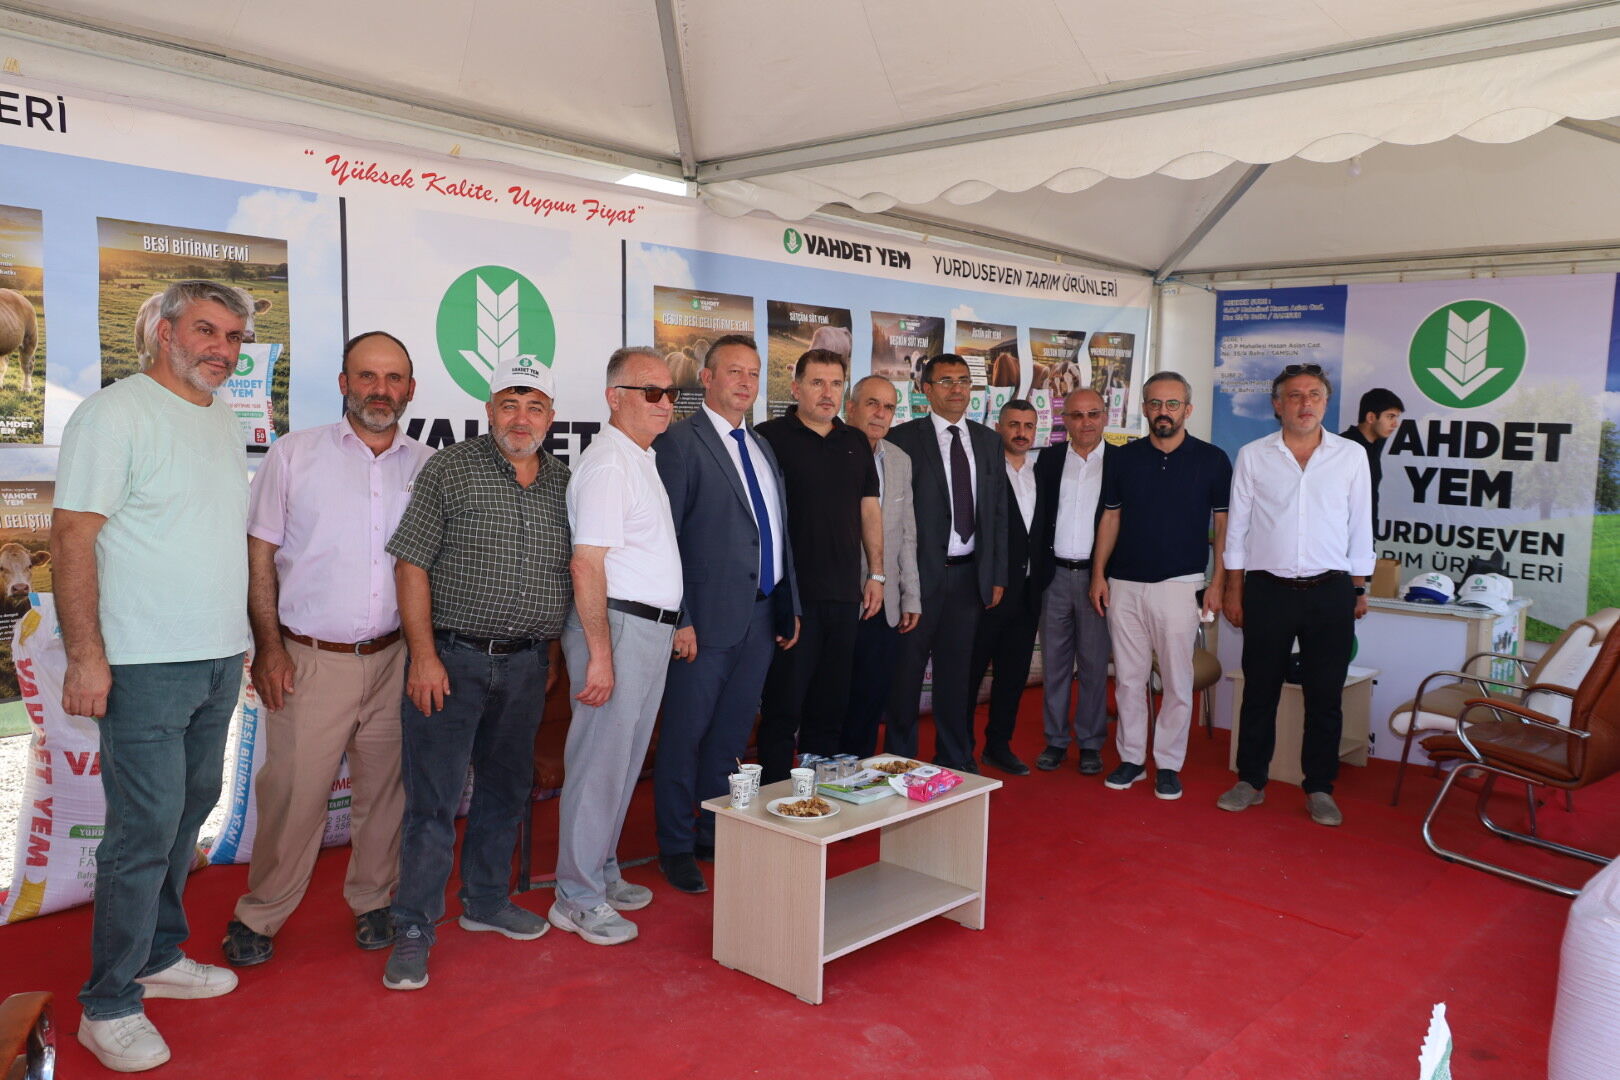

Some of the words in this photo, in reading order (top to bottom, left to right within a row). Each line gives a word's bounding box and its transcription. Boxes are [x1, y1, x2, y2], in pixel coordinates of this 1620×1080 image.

[0, 91, 67, 133] ERİ
[508, 186, 577, 217] Uygun
[143, 236, 169, 252] BESİ
[173, 238, 219, 258] BİTİRME
[222, 245, 249, 261] YEMİ
[804, 233, 872, 263] VAHDET
[876, 247, 911, 269] YEM
[933, 256, 1022, 286] YURDUSEVEN
[1026, 271, 1060, 290] TARIM
[1063, 273, 1118, 297] ÜRÜNLERİ
[223, 379, 263, 389] AHDET
[231, 389, 253, 397] YEM
[1388, 419, 1572, 462] AHDET
[1404, 466, 1513, 508] YEM
[5, 512, 52, 532] GELİŞTİR
[1374, 519, 1565, 557] URDUSEVEN
[1432, 551, 1562, 583] ÜRLERİ
[236, 748, 250, 804] BİTİRME
[26, 797, 53, 867] YEM
[228, 813, 242, 845] YEMİ
